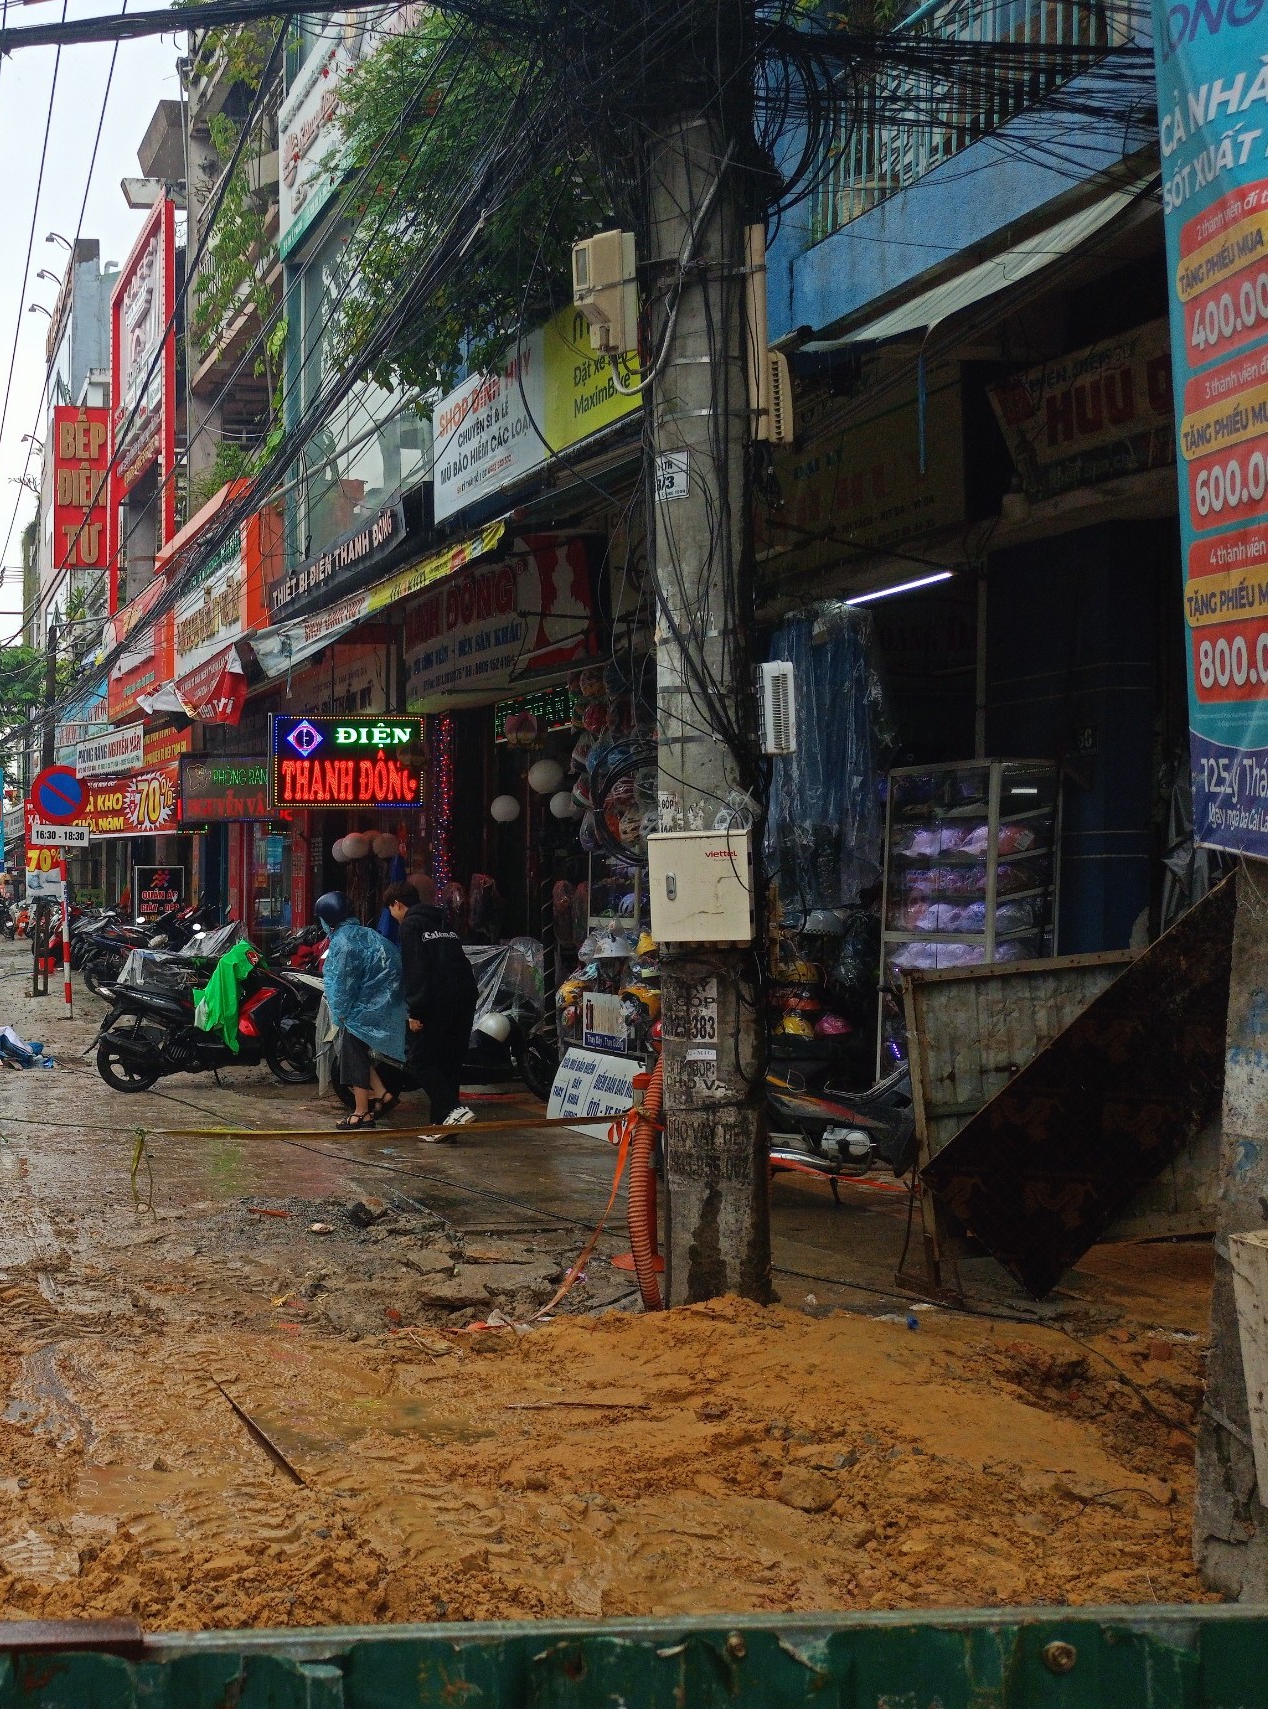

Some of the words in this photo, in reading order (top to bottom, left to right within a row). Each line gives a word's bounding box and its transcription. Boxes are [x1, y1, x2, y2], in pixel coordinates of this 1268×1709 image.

[1161, 89, 1186, 157] CẢ
[1164, 160, 1191, 215] SỐT
[1194, 122, 1263, 193] XUẤT
[1179, 261, 1205, 295] TẶNG
[1205, 240, 1233, 276] PHIẾU
[1234, 227, 1264, 262] MUA
[574, 362, 591, 389] Đặt
[574, 373, 631, 418] MaximBke
[60, 406, 107, 459] BẾP
[439, 397, 469, 438] SHOP
[457, 417, 485, 449] CHUYÊN
[1183, 423, 1213, 455] TẶNG
[1214, 402, 1249, 440] PHIẾU
[490, 427, 509, 454] CÁC
[57, 461, 107, 513] ĐIỆN
[1196, 451, 1268, 515] 600.0
[299, 571, 308, 596] BỊ
[310, 552, 332, 587] ĐIỆN
[334, 530, 369, 570] THANH
[1217, 540, 1246, 565] thành
[1187, 589, 1218, 622] TẶNG
[1219, 577, 1255, 613] PHIẾU
[335, 722, 412, 748] ĐIỆN
[213, 766, 246, 786] PHÒNG
[249, 766, 267, 785] RĂN
[282, 760, 354, 800] THANH
[97, 792, 123, 812] KHO
[135, 777, 173, 825] 70%
[35, 829, 57, 840] 16:30
[64, 831, 85, 841] 18:30
[705, 850, 737, 859] viettel
